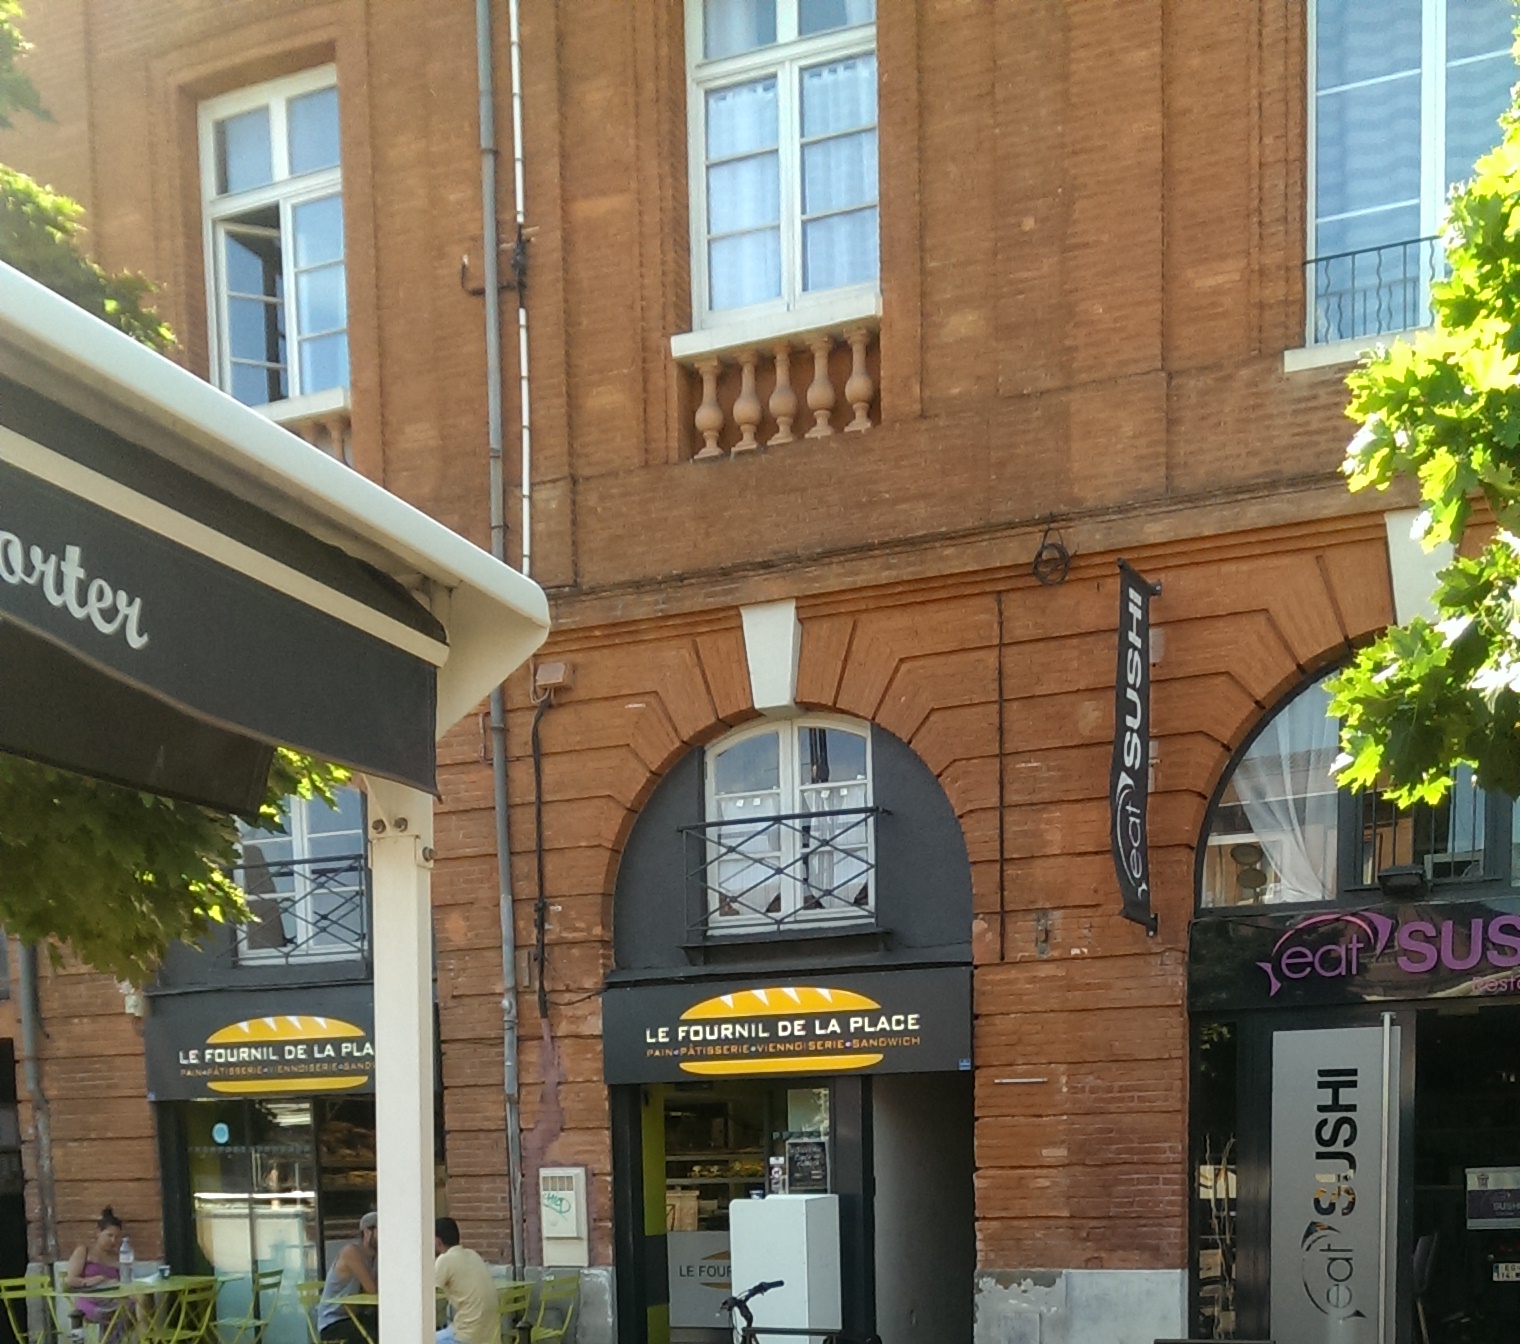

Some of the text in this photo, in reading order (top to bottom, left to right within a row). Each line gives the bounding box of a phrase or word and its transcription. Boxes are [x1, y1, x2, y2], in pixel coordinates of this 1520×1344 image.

[1123, 587, 1143, 880] eat SUSHI
[1280, 914, 1520, 980] eat SUS
[646, 1014, 921, 1043] LE FOURNIL DE LA PLACE
[178, 1050, 200, 1065] LE
[205, 1046, 279, 1063] FOURNIL
[284, 1044, 308, 1060] DE
[313, 1043, 335, 1059] LA
[343, 1060, 375, 1072] SAND
[1313, 1068, 1359, 1310] eat SUSHI
[679, 1265, 695, 1278] LE
